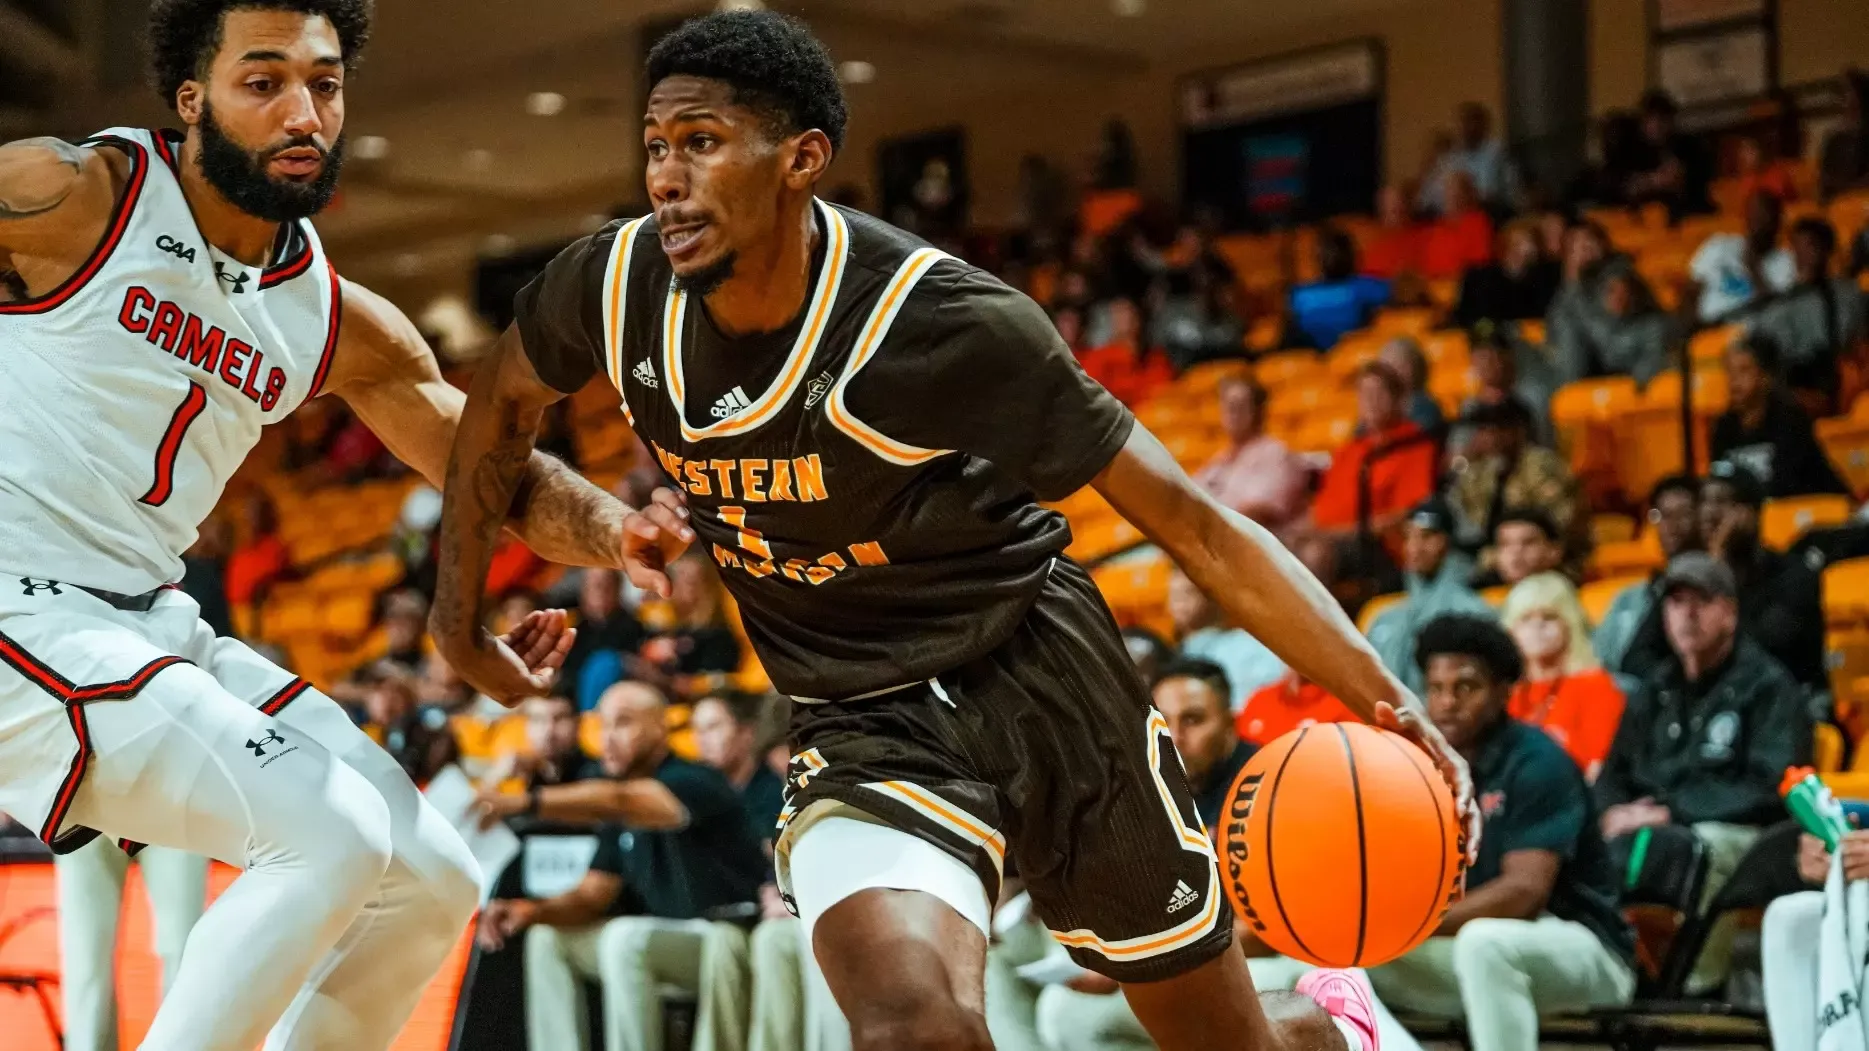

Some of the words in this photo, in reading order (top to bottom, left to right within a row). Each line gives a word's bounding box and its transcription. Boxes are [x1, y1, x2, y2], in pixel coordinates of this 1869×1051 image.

[155, 234, 197, 263] CAA
[118, 285, 287, 412] CAMELS
[632, 368, 659, 389] addas
[710, 405, 743, 419] adid
[136, 379, 207, 507] 1
[1227, 770, 1267, 931] Wilson
[1167, 890, 1199, 913] adidas
